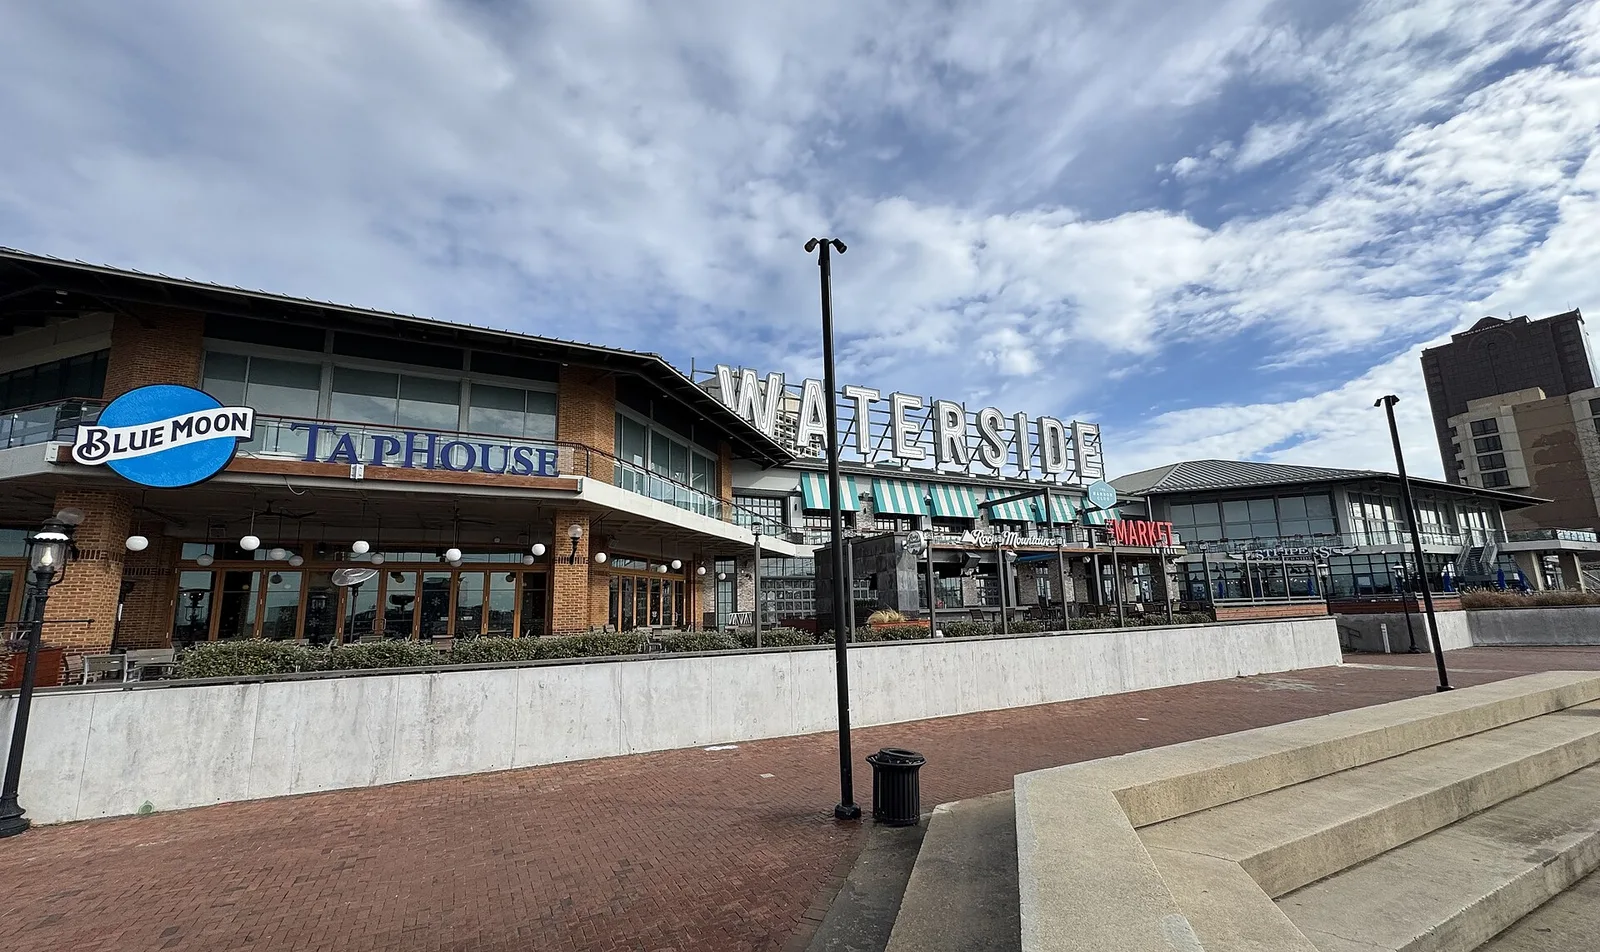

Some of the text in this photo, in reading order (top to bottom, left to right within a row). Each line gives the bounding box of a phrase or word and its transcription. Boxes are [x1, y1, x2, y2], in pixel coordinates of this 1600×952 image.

[76, 412, 248, 461] BLUE MOON
[715, 363, 1102, 479] WATERSIDE
[290, 421, 560, 478] TAPHOUSE
[1115, 519, 1173, 546] MARKET
